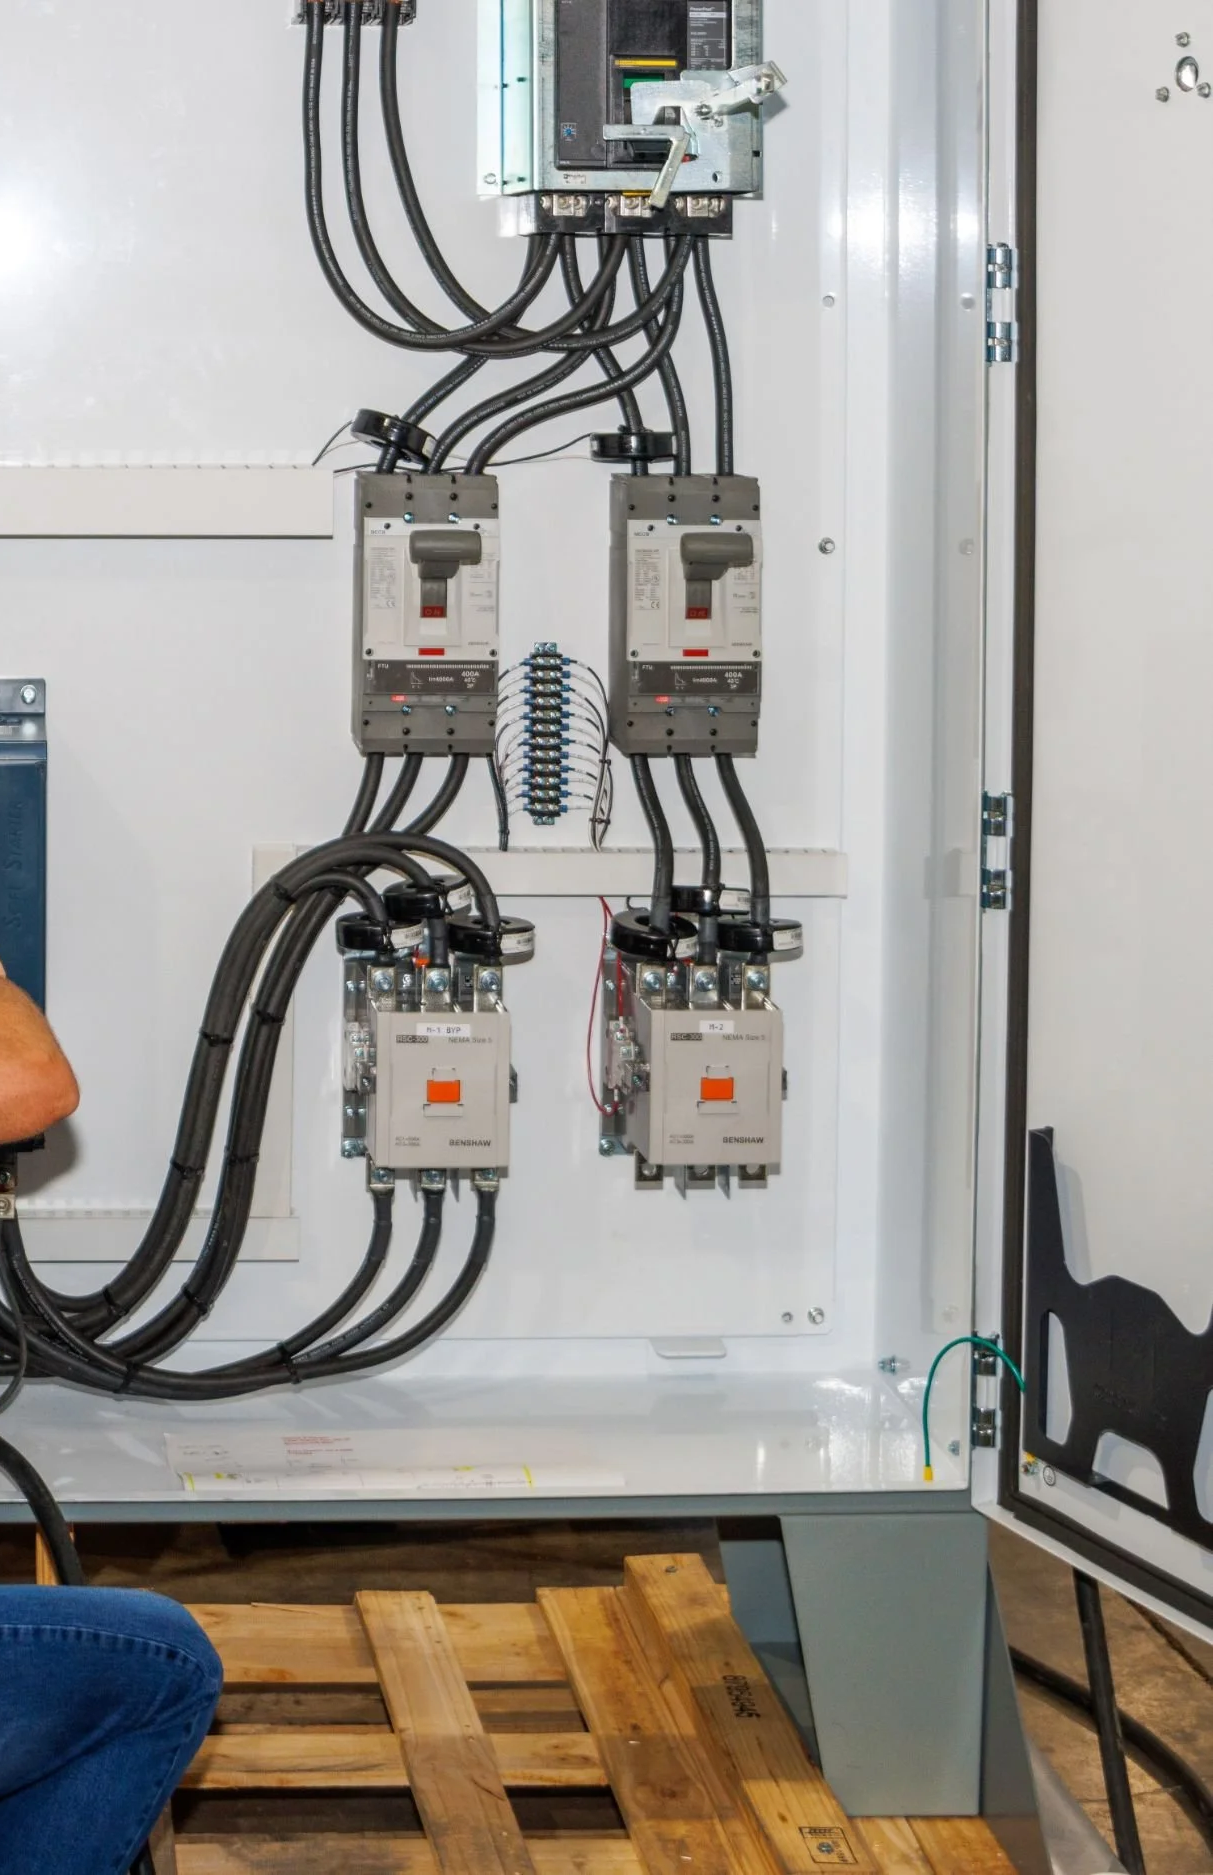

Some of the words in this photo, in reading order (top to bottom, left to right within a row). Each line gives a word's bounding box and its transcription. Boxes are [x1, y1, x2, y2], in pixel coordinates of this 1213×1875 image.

[426, 1026, 441, 1034] M-1
[446, 1026, 461, 1034] BYP
[708, 1023, 724, 1031] M-2
[448, 1036, 471, 1044] NEMA
[722, 1033, 744, 1041] NEMA
[448, 1138, 492, 1147] BENSHAW
[722, 1136, 765, 1144] BENSHAW
